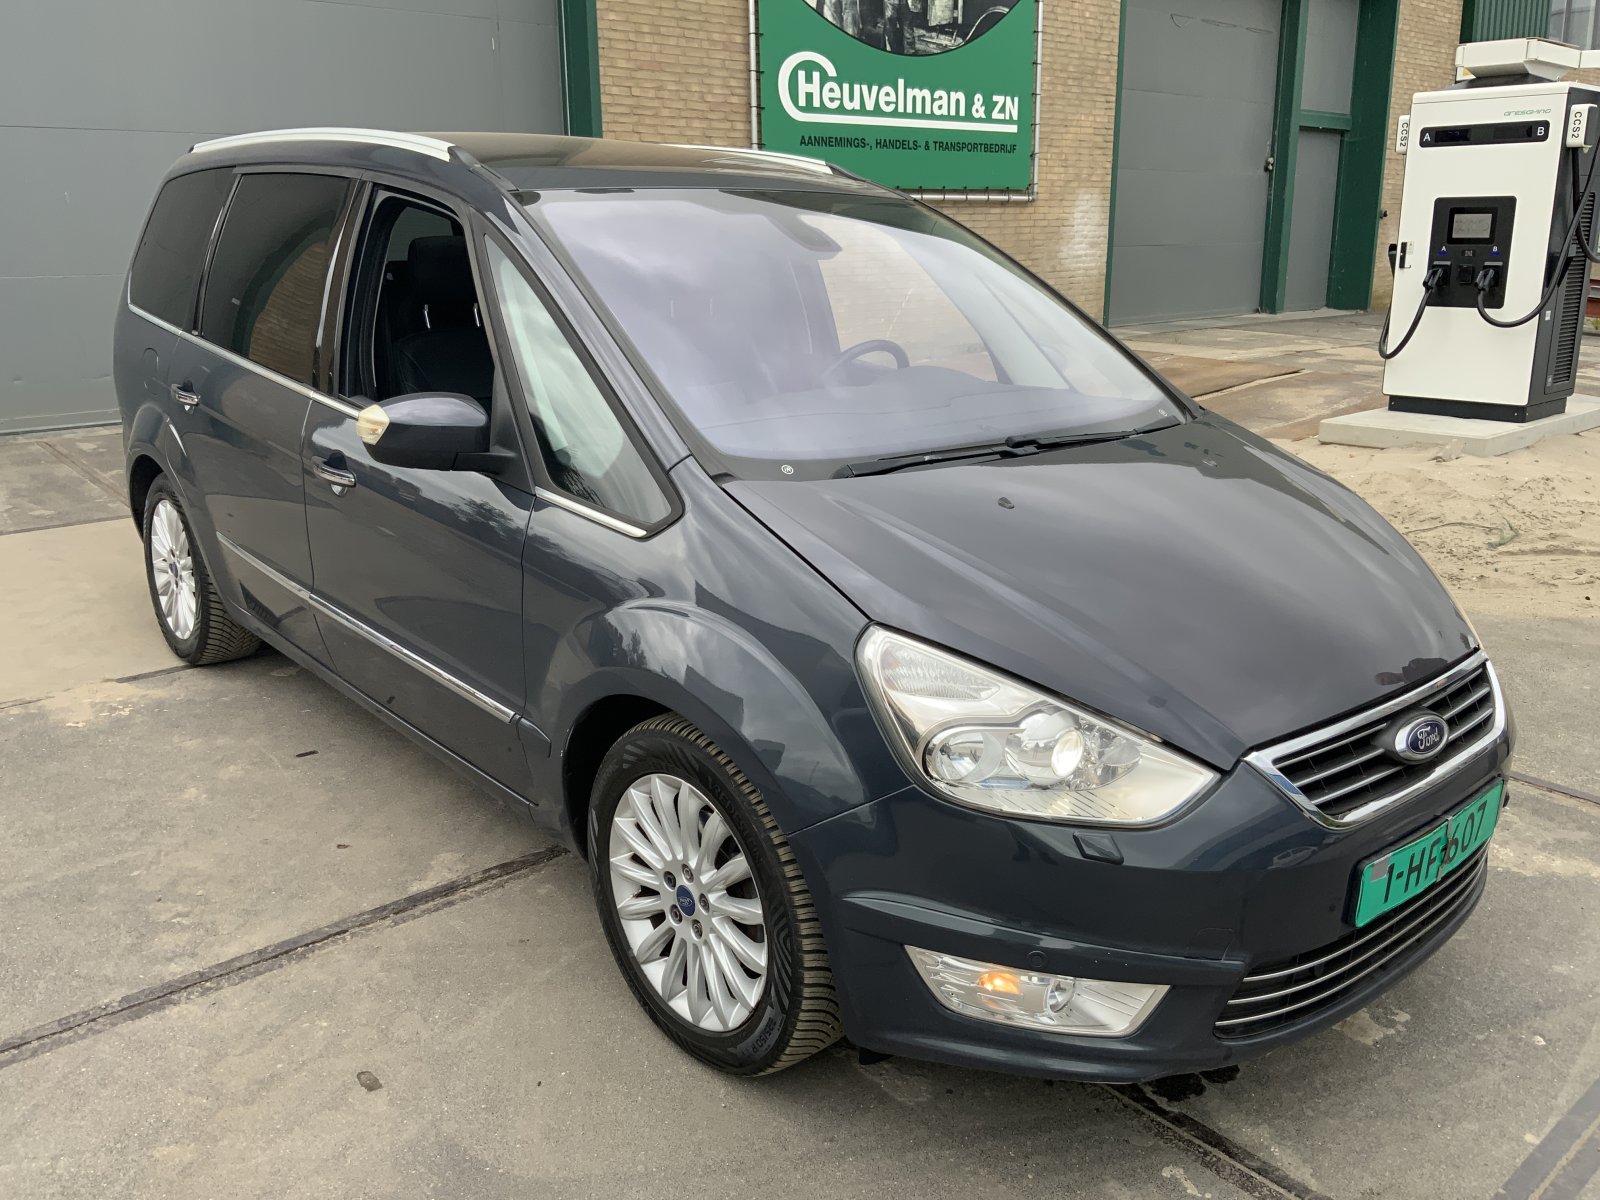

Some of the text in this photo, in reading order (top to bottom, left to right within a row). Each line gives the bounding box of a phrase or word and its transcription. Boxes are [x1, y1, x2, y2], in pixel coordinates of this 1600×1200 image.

[971, 93, 986, 119] &
[991, 95, 1019, 121] ZN
[1399, 122, 1409, 147] CCS2
[1423, 132, 1431, 142] A
[1536, 126, 1545, 136] B
[1571, 111, 1583, 139] CCS2
[799, 135, 1017, 154] AANNEMINGS-, HANDELS- & TRANSPORTBEDRIJF
[1417, 722, 1440, 750] Ford
